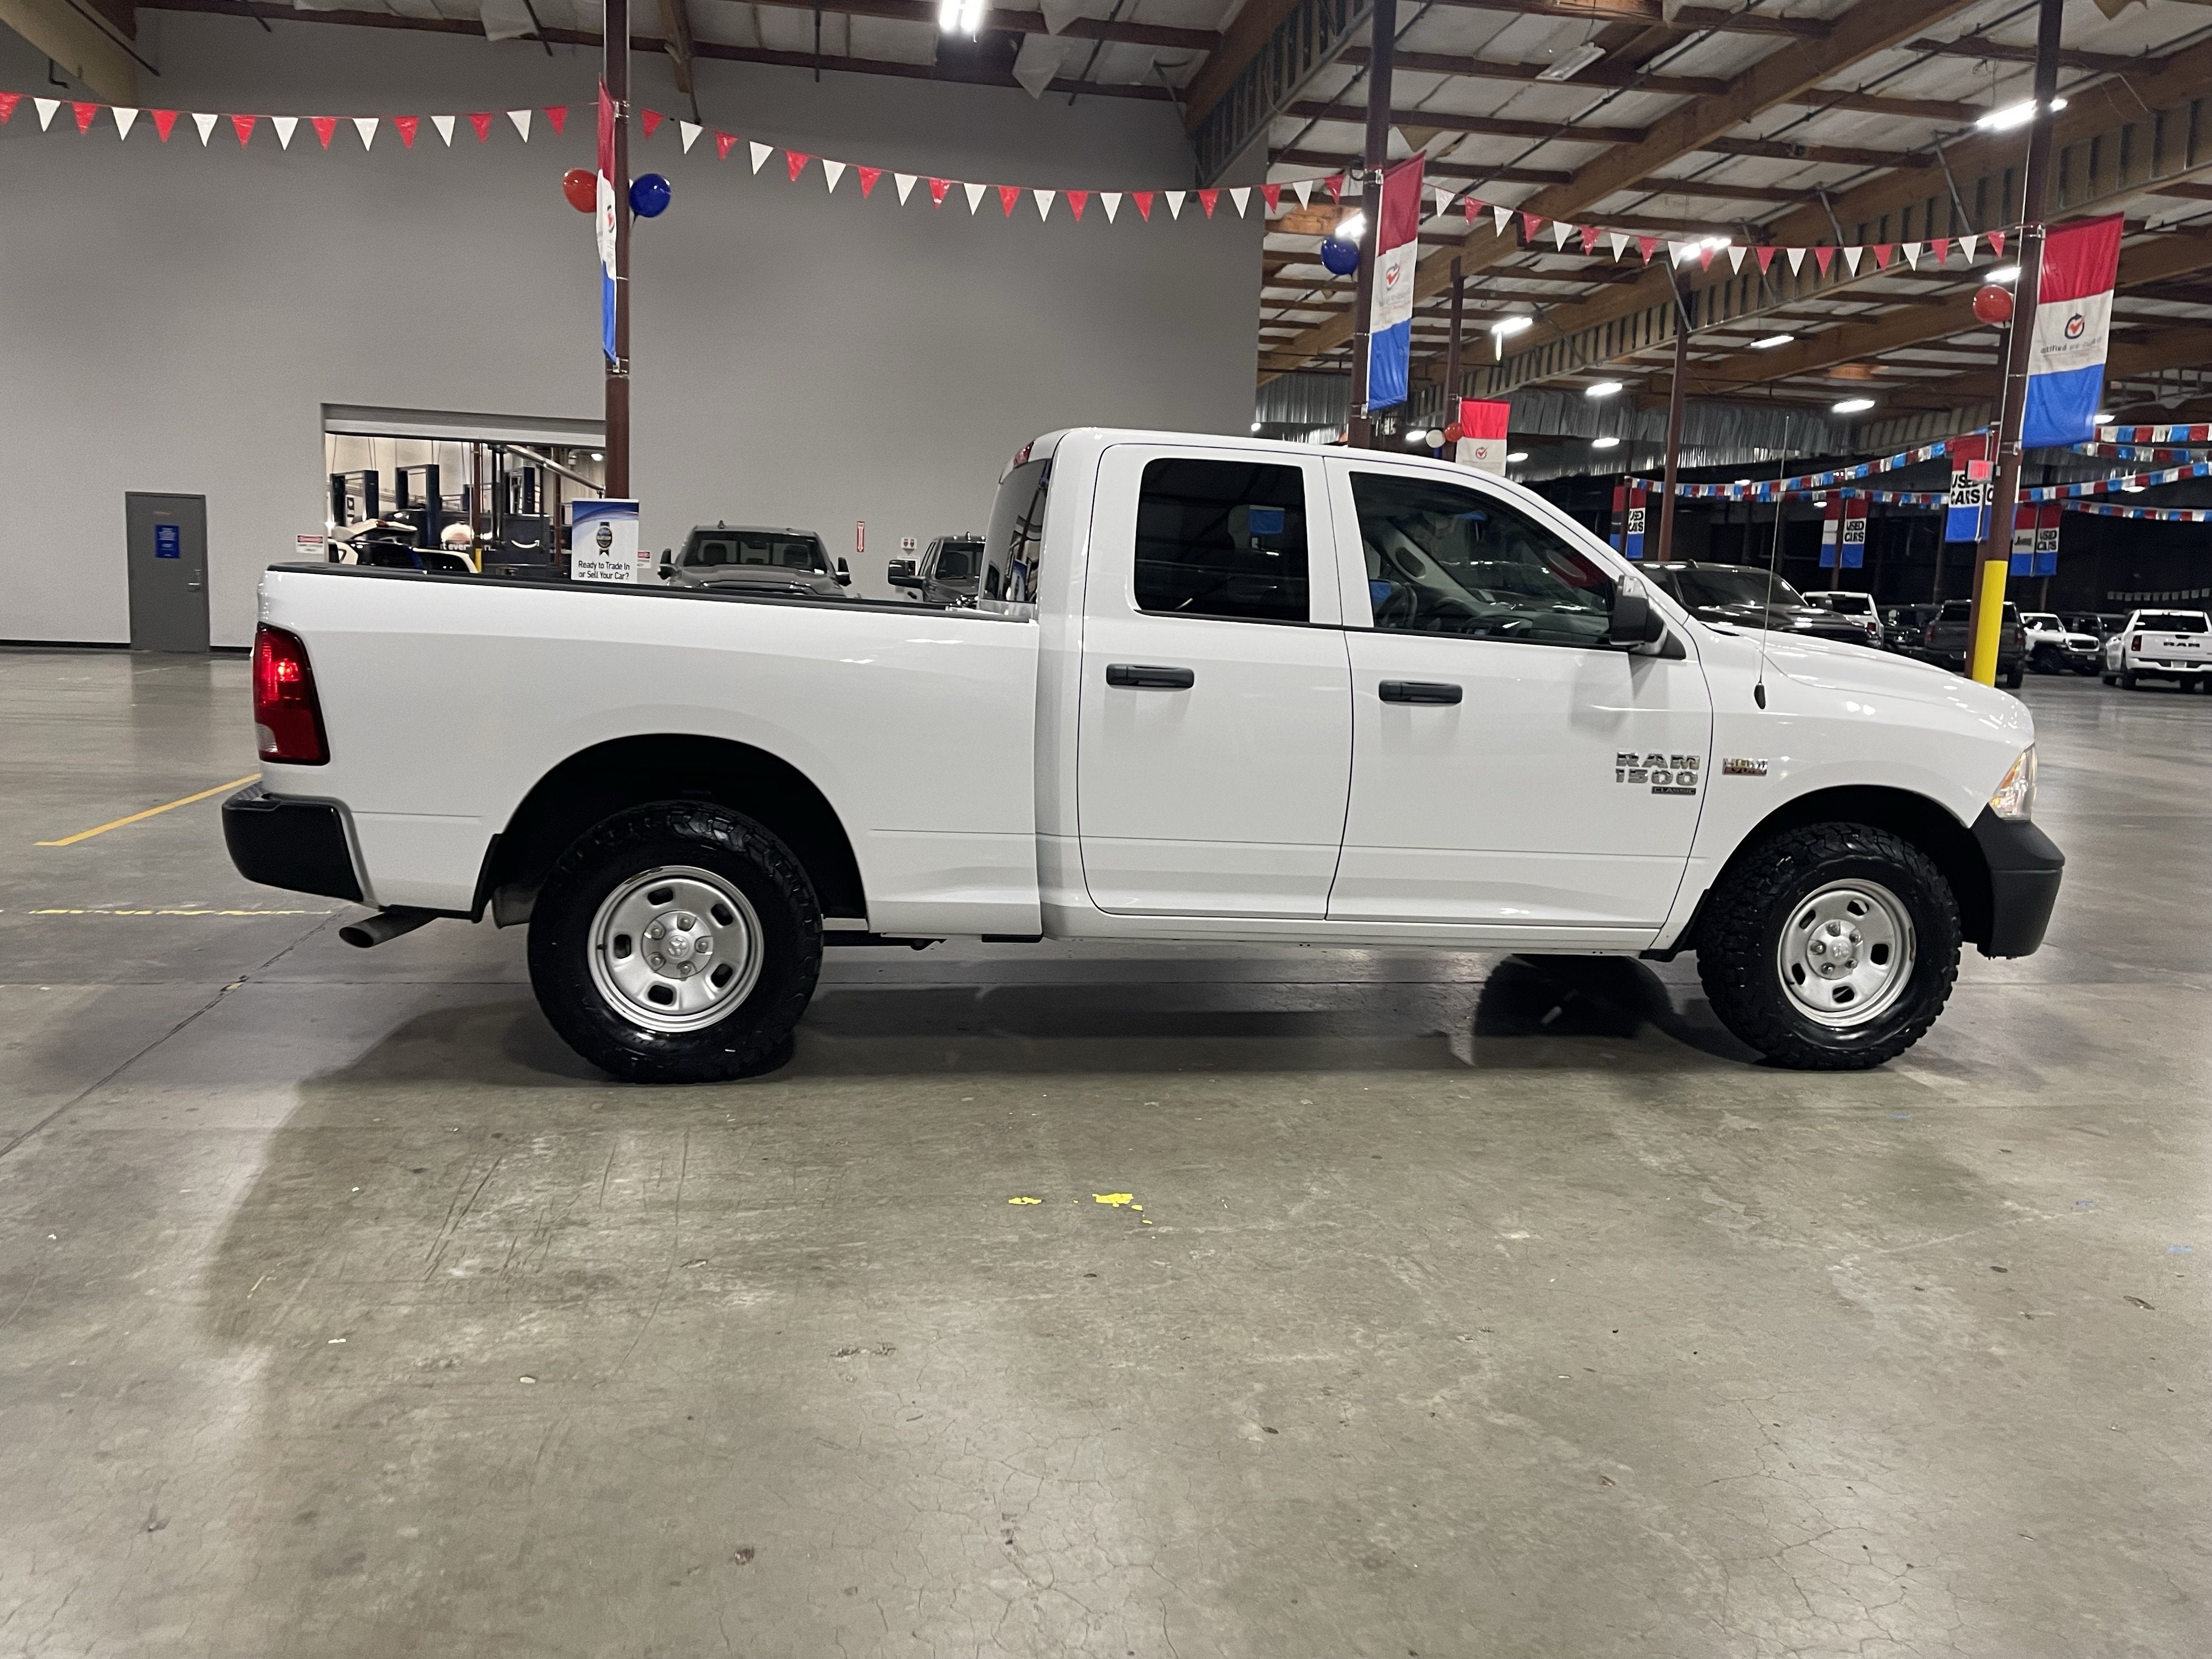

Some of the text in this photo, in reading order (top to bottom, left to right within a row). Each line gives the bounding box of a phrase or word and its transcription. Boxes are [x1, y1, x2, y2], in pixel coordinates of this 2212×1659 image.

[578, 560, 597, 571] Ready
[606, 562, 623, 570] Trade
[624, 562, 630, 571] In
[587, 571, 598, 579] Sell
[614, 572, 629, 580] Car?
[1616, 752, 1701, 770] RAM
[1615, 768, 1699, 786] 1500
